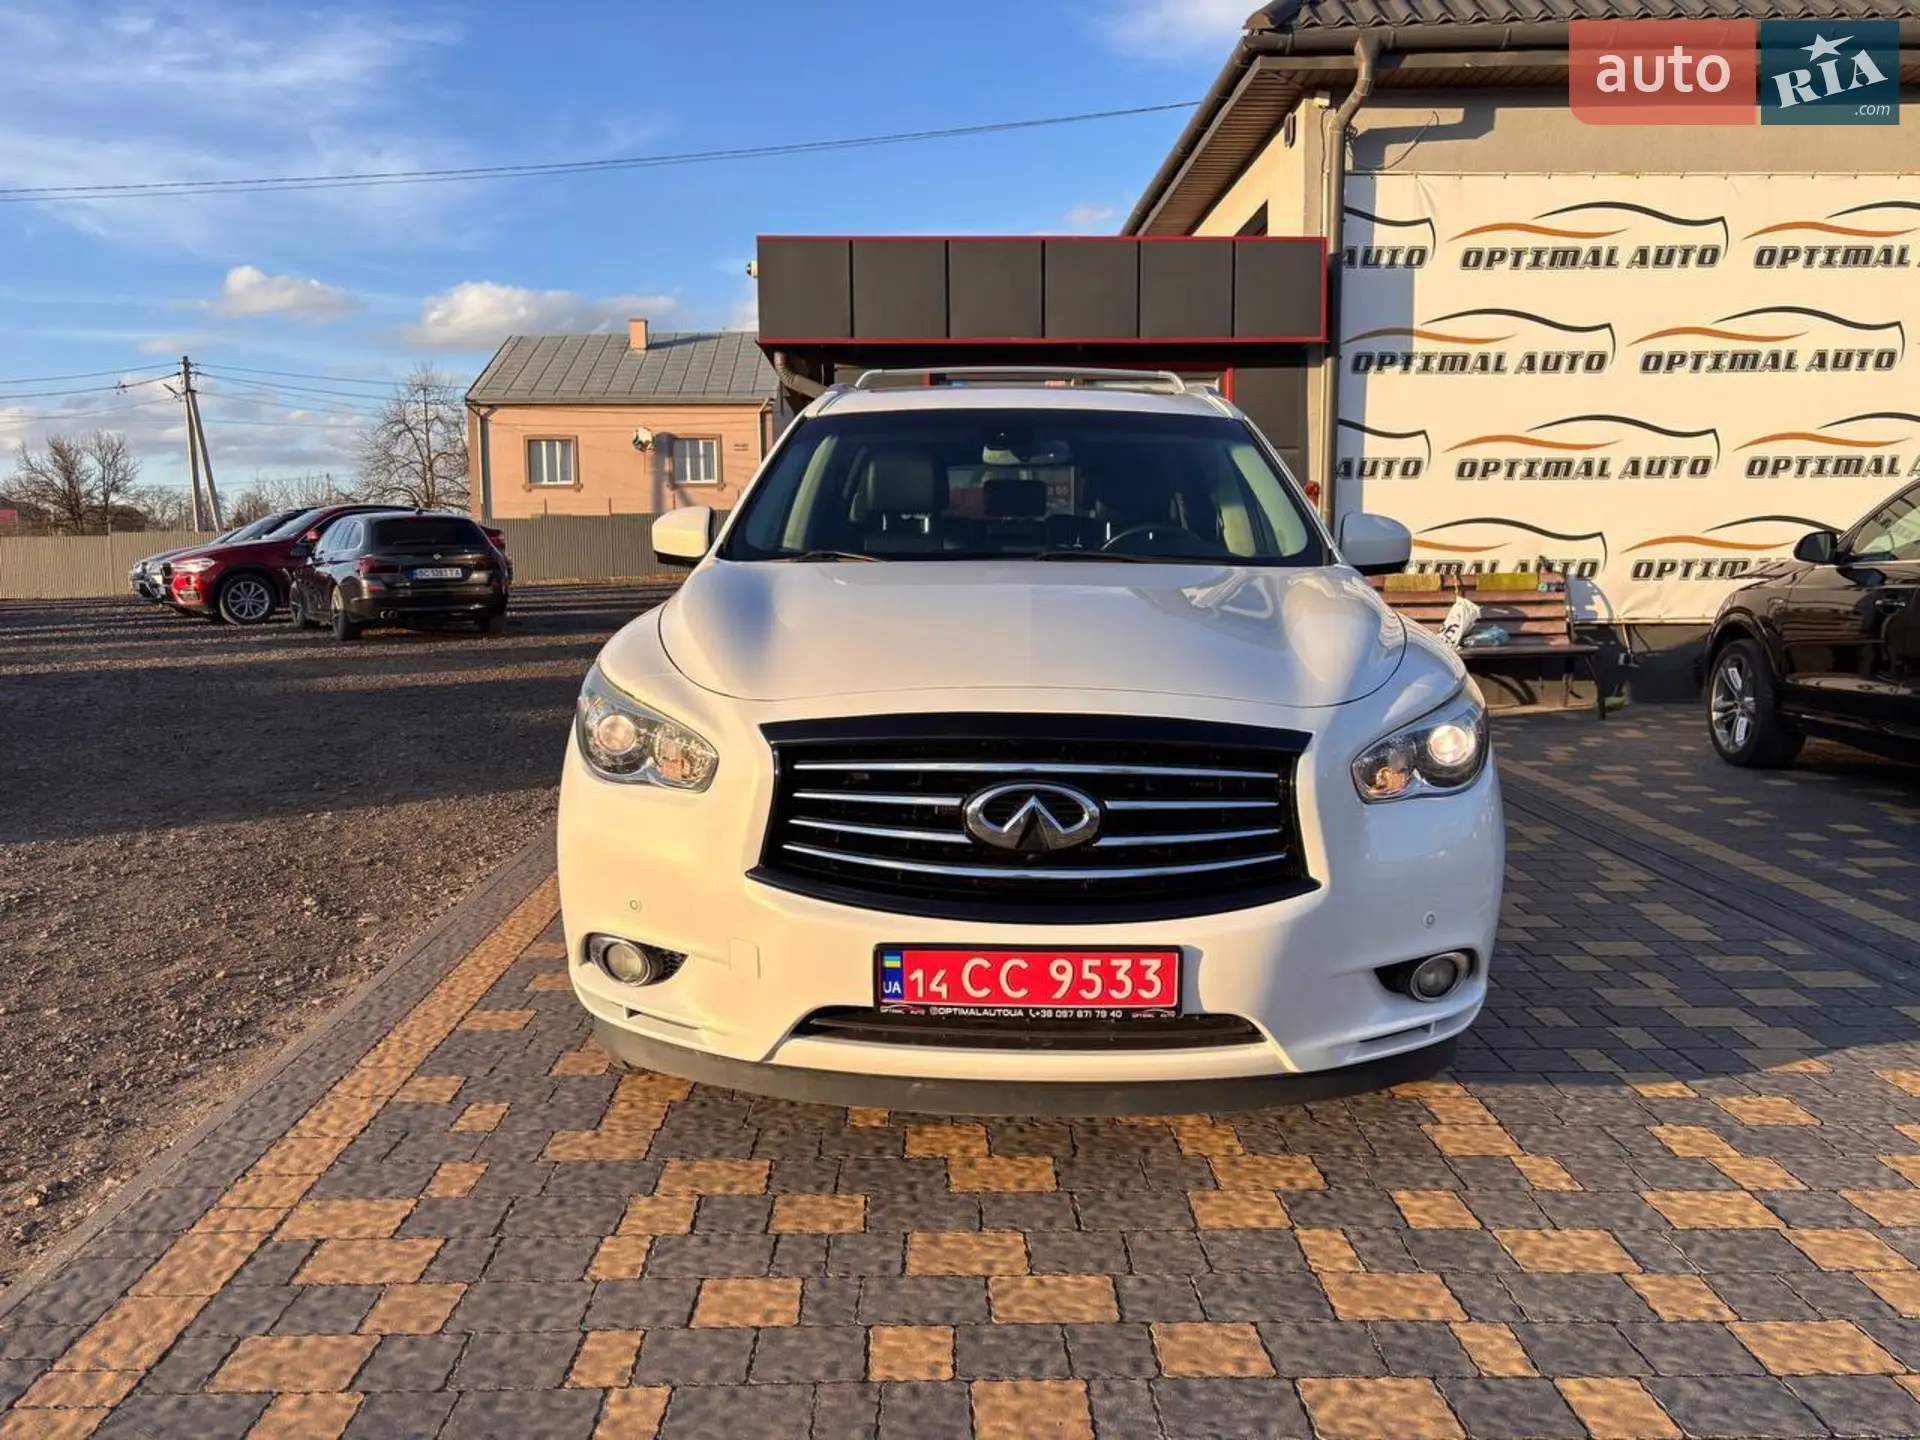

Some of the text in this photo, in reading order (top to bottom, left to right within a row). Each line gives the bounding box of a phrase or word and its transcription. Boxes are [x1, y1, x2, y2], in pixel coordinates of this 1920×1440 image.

[1341, 245, 1429, 269] AUTO
[1460, 244, 1721, 270] OPTIMAL AUTO
[1753, 245, 1911, 269] OPTIMAL
[1350, 350, 1608, 375] OPTIMAL AUTO
[1639, 348, 1899, 374] OPTIMAL AUTO
[1335, 457, 1424, 480] AUTO
[1455, 455, 1713, 481] OPTIMAL AUTO
[1744, 454, 1901, 479] OPTIMAL
[1403, 559, 1501, 574] IMAL
[1630, 558, 1790, 581] OPTIM
[883, 980, 902, 994] UA
[908, 957, 1164, 1000] 14 CC 9533
